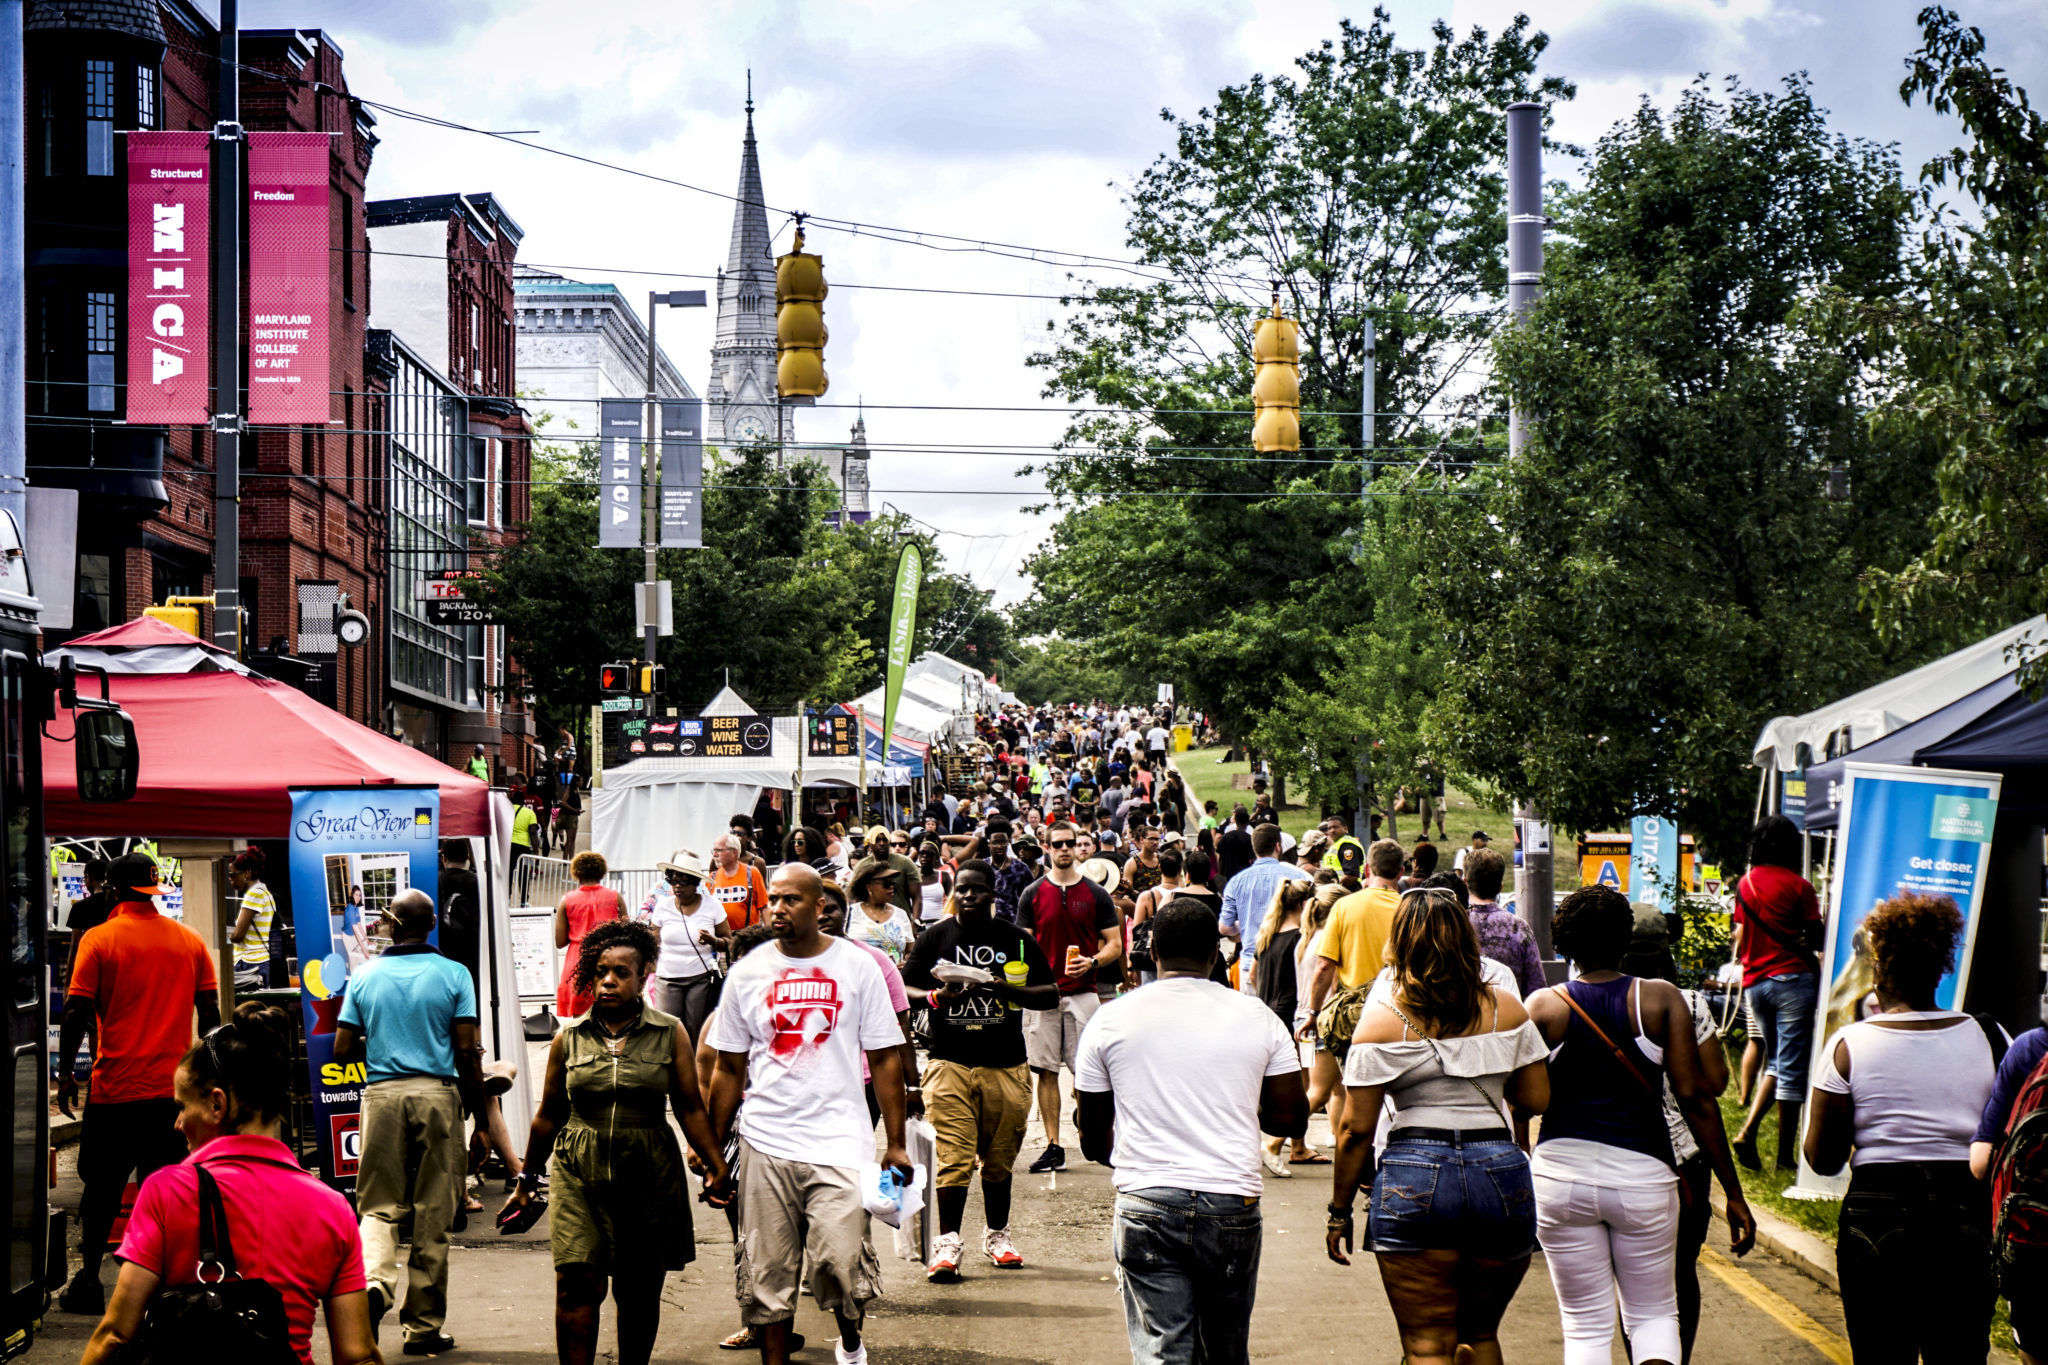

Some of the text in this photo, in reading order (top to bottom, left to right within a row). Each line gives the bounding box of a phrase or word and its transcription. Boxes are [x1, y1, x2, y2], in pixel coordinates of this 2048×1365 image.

[150, 168, 203, 178] Structured
[254, 191, 295, 201] Freedom
[255, 315, 312, 325] MARYLAND
[255, 329, 309, 340] INSTITUTE
[255, 344, 299, 354] COLLEGE
[255, 359, 291, 369] OF ART
[458, 611, 493, 621] 1204
[604, 701, 633, 710] DOLPHIN
[622, 719, 647, 732] ROLLING
[712, 717, 740, 729] BEER
[628, 729, 642, 737] ROCK
[711, 731, 740, 742] WINE
[706, 744, 743, 755] WATER
[295, 806, 412, 842] Great View
[1941, 817, 1984, 829] NATIONAL
[1940, 825, 1984, 836] AQUARIUM
[1910, 856, 1974, 874] Get closer.
[777, 982, 833, 1001] PUMA
[320, 1062, 367, 1086] SAV
[321, 1089, 359, 1104] towards
